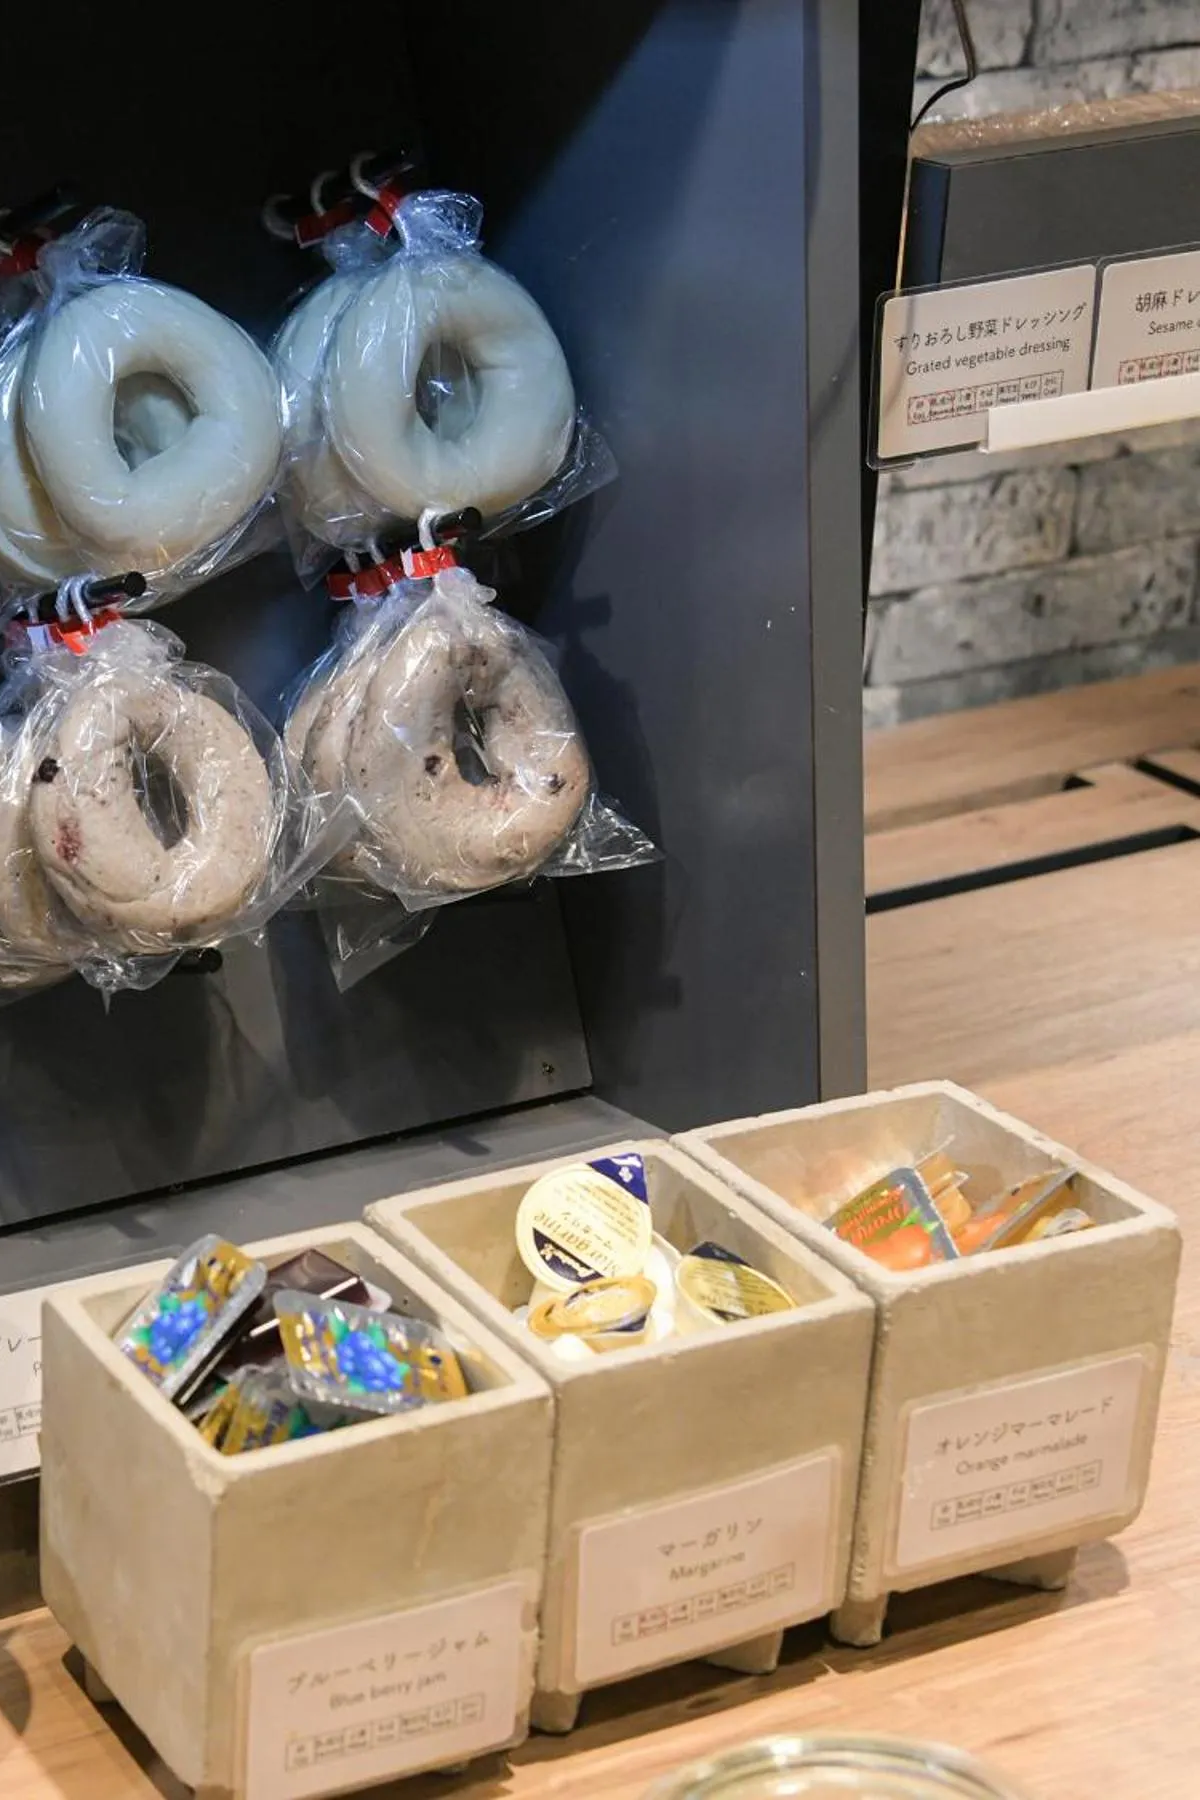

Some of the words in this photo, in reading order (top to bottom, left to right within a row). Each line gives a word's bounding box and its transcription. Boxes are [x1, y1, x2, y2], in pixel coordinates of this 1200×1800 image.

[894, 302, 1087, 350] すりおろし野菜ドレッシング
[1148, 320, 1194, 335] Sesame
[906, 355, 952, 376] Grated
[955, 346, 1016, 370] vegetable
[1019, 336, 1071, 358] dressing
[934, 1396, 1114, 1456] オレンジマーマレード
[956, 1453, 1009, 1476] Orange
[1013, 1433, 1088, 1460] marmalade
